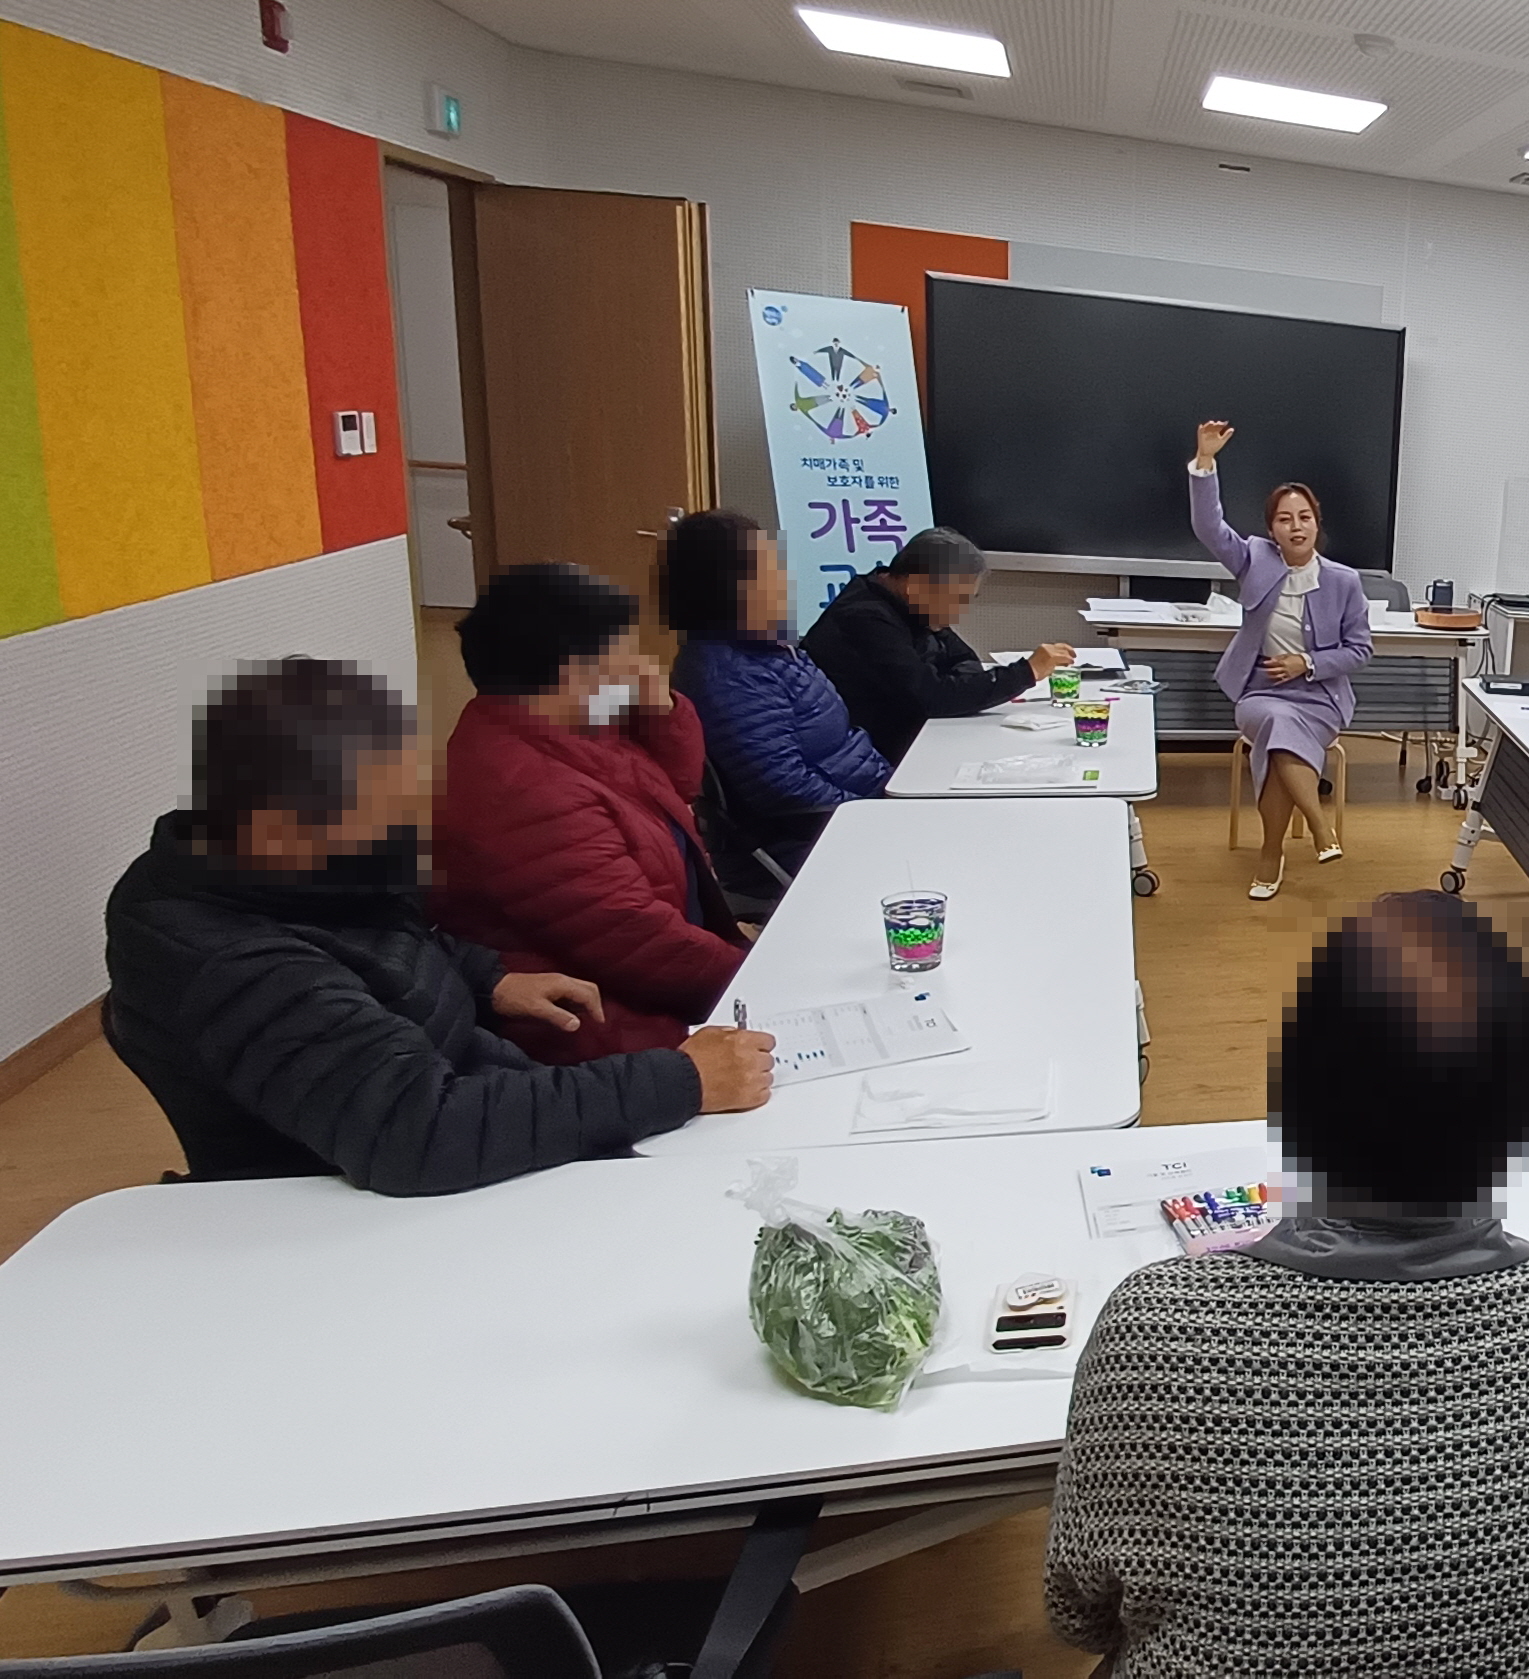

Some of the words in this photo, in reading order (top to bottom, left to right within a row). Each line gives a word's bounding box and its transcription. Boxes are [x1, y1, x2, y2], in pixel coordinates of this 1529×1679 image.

[801, 457, 850, 472] 치매가족
[852, 458, 864, 472] 및
[827, 475, 874, 489] 보호자를
[877, 475, 900, 489] 위한
[807, 498, 908, 554] 가족
